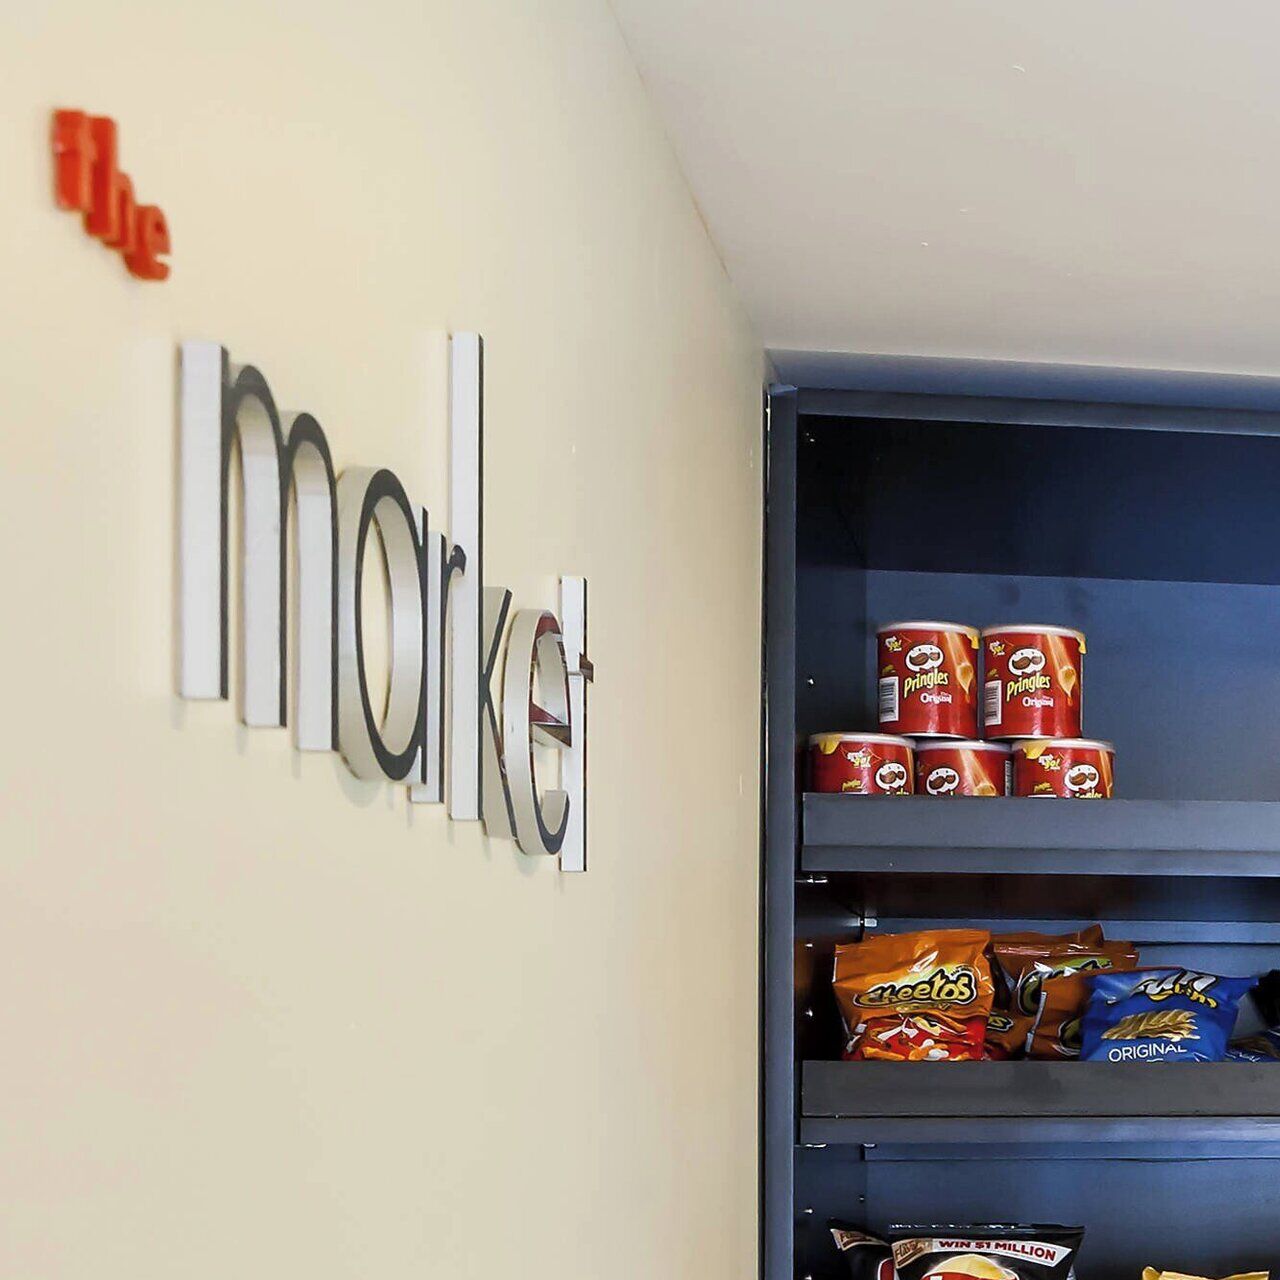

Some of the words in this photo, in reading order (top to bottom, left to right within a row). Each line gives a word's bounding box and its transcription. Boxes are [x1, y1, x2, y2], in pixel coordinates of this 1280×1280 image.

[53, 108, 171, 281] the
[178, 332, 594, 871] market
[904, 668, 948, 698] Pringles
[1006, 672, 1051, 702] Pringles
[857, 967, 976, 1006] Cheetos
[1108, 1043, 1187, 1062] ORIGINAL
[939, 1240, 970, 1249] WIN
[975, 1240, 991, 1249] $1
[994, 1241, 1057, 1262] MILLION
